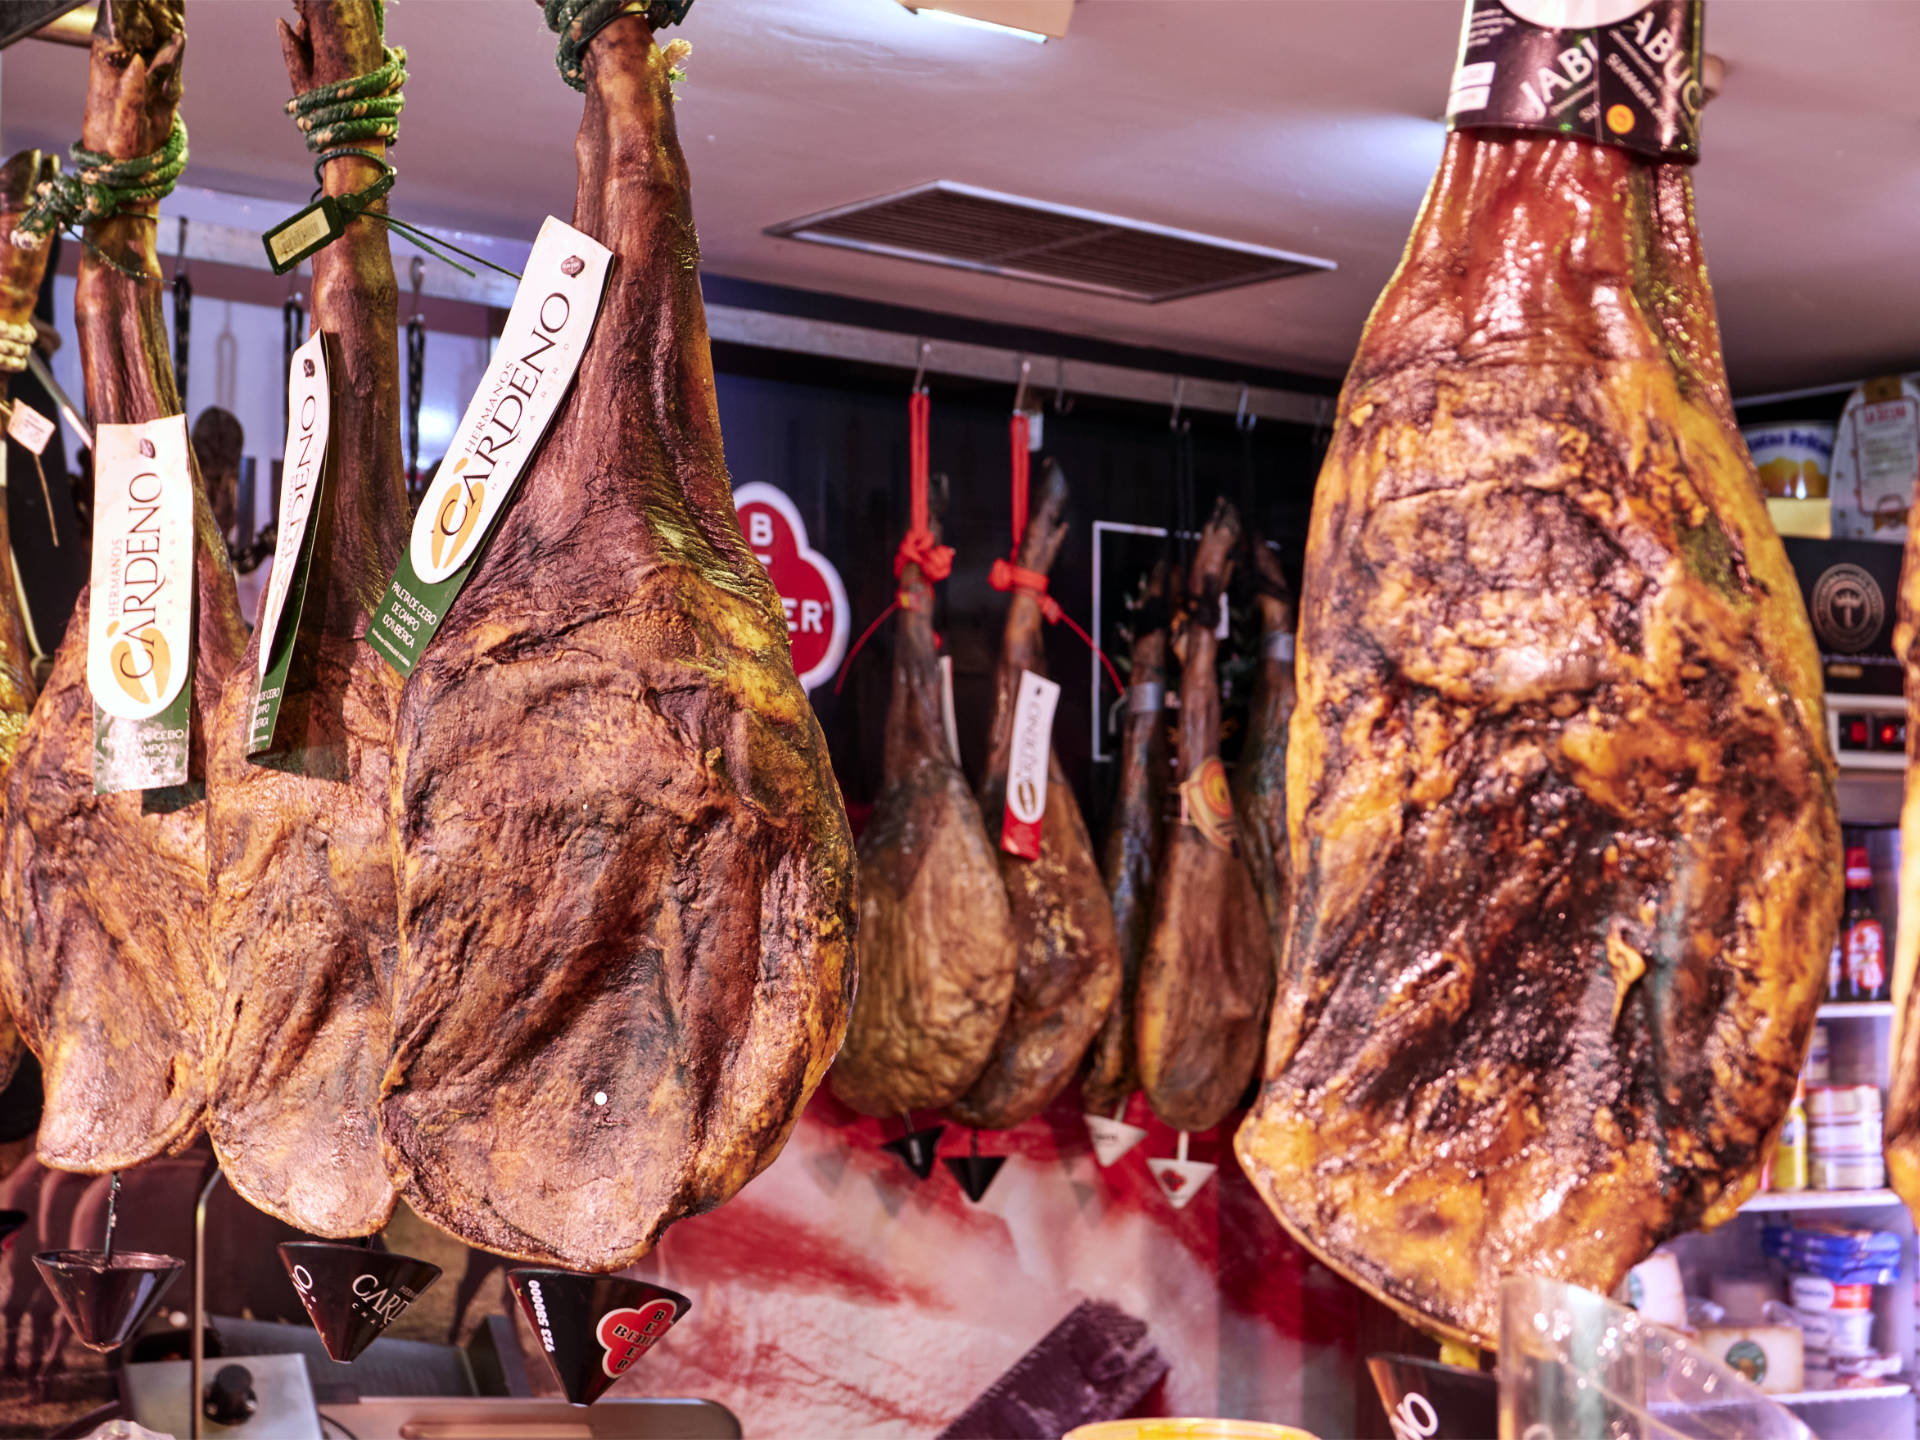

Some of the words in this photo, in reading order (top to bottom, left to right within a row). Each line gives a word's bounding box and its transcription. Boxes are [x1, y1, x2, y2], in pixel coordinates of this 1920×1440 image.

[440, 292, 570, 537] CARDENO
[465, 361, 514, 453] HERMANOS
[108, 538, 122, 617] HERMANOS
[120, 472, 166, 679] CARDENO
[417, 604, 437, 625] CEBO
[398, 608, 420, 632] CAMPO
[540, 1328, 555, 1352] 923
